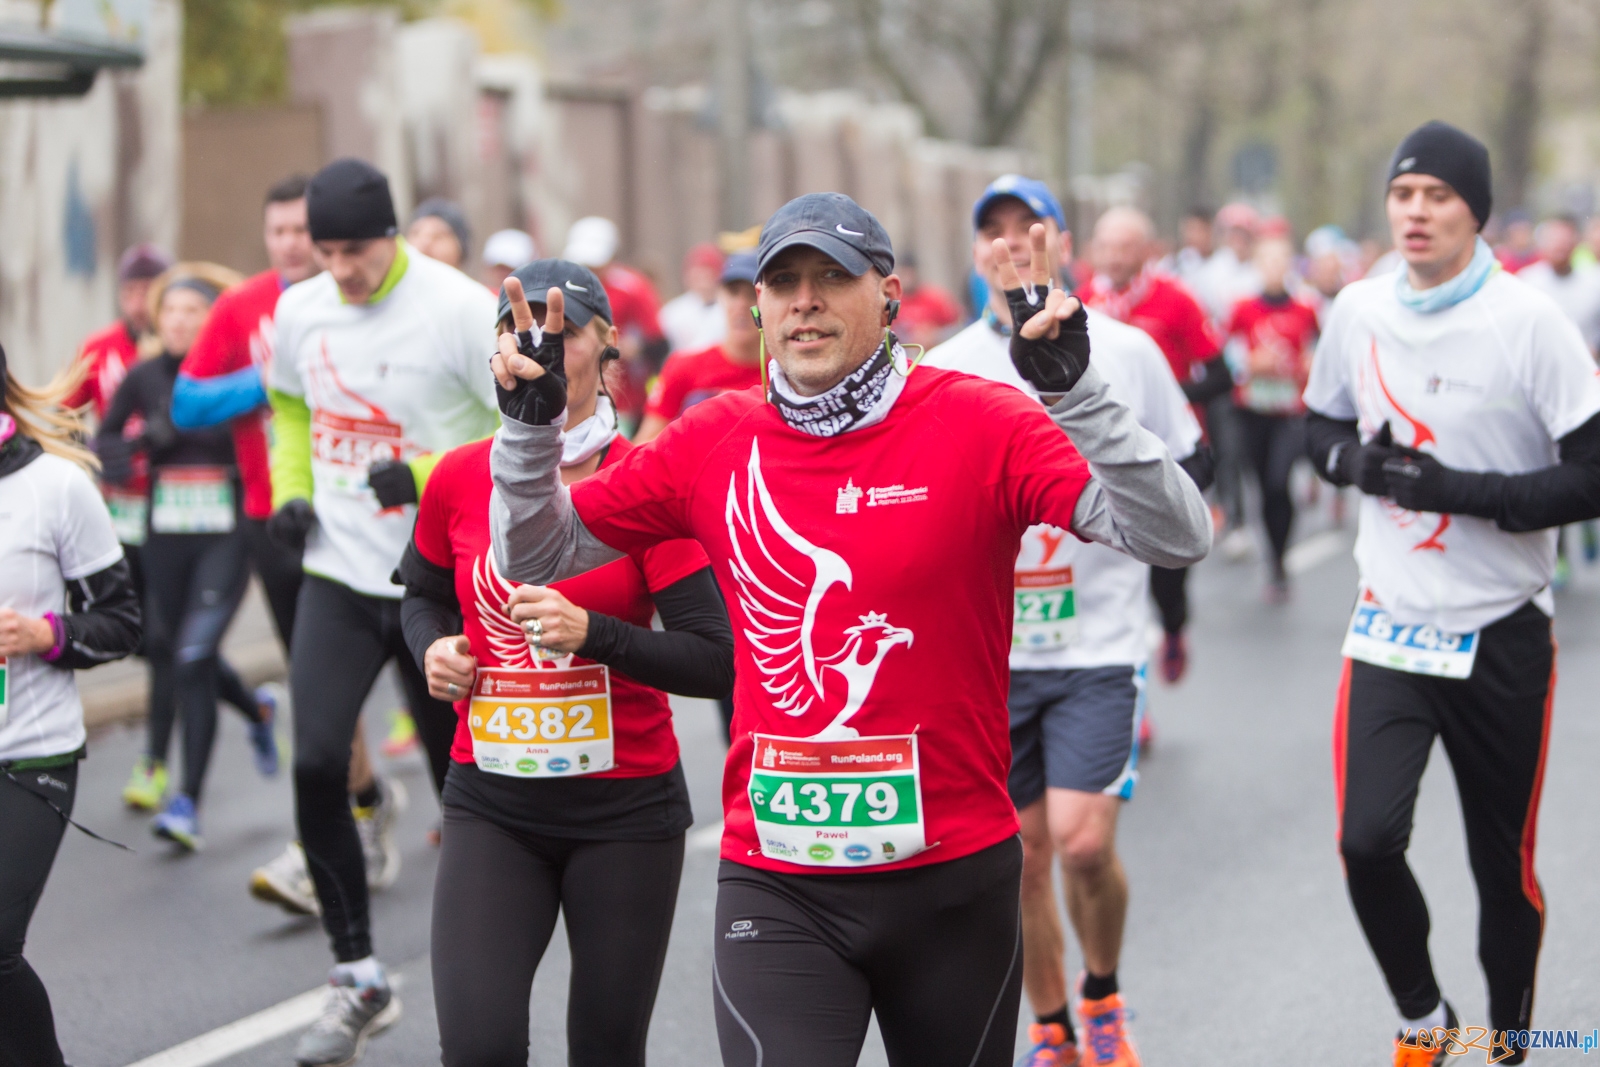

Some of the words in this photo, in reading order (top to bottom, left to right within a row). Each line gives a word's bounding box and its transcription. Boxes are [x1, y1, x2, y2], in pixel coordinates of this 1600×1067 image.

[866, 486, 878, 507] 1
[539, 679, 598, 691] RunPoland.org
[472, 715, 482, 727] D
[485, 704, 595, 740] 4382
[831, 752, 903, 764] RunPoland.org
[769, 782, 899, 822] 4379
[724, 929, 759, 939] Kalenji
